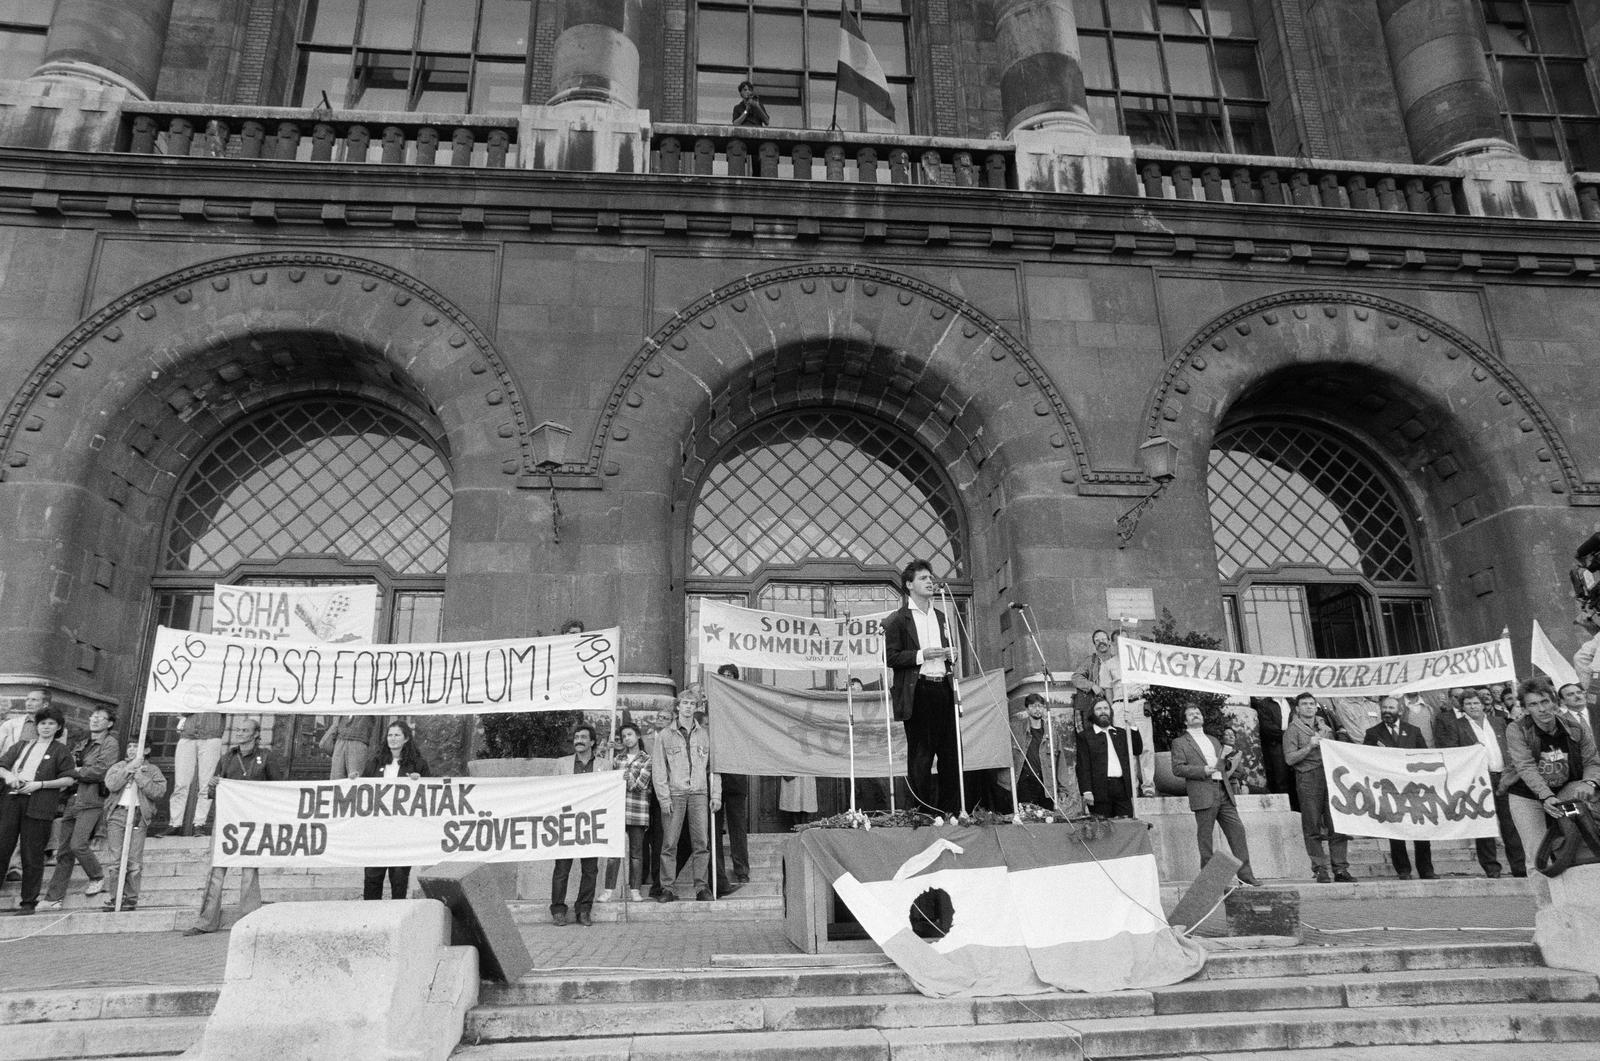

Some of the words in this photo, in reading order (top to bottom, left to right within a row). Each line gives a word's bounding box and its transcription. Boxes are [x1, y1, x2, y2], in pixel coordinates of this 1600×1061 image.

[217, 591, 290, 627] SOHA
[760, 616, 822, 637] SOHA
[834, 618, 886, 638] TÖB
[152, 633, 207, 694] 1956
[574, 633, 616, 697] 1956
[728, 632, 880, 656] KOMMUNIZMU
[1125, 644, 1246, 684] MAGYAR
[1256, 660, 1409, 689] DEMOKRATA
[331, 643, 552, 705] FORRADALOM!
[296, 778, 477, 820] DEMOKRATÁK
[221, 821, 328, 857] SZABAD
[440, 804, 609, 854] SZÖVETSÉGE
